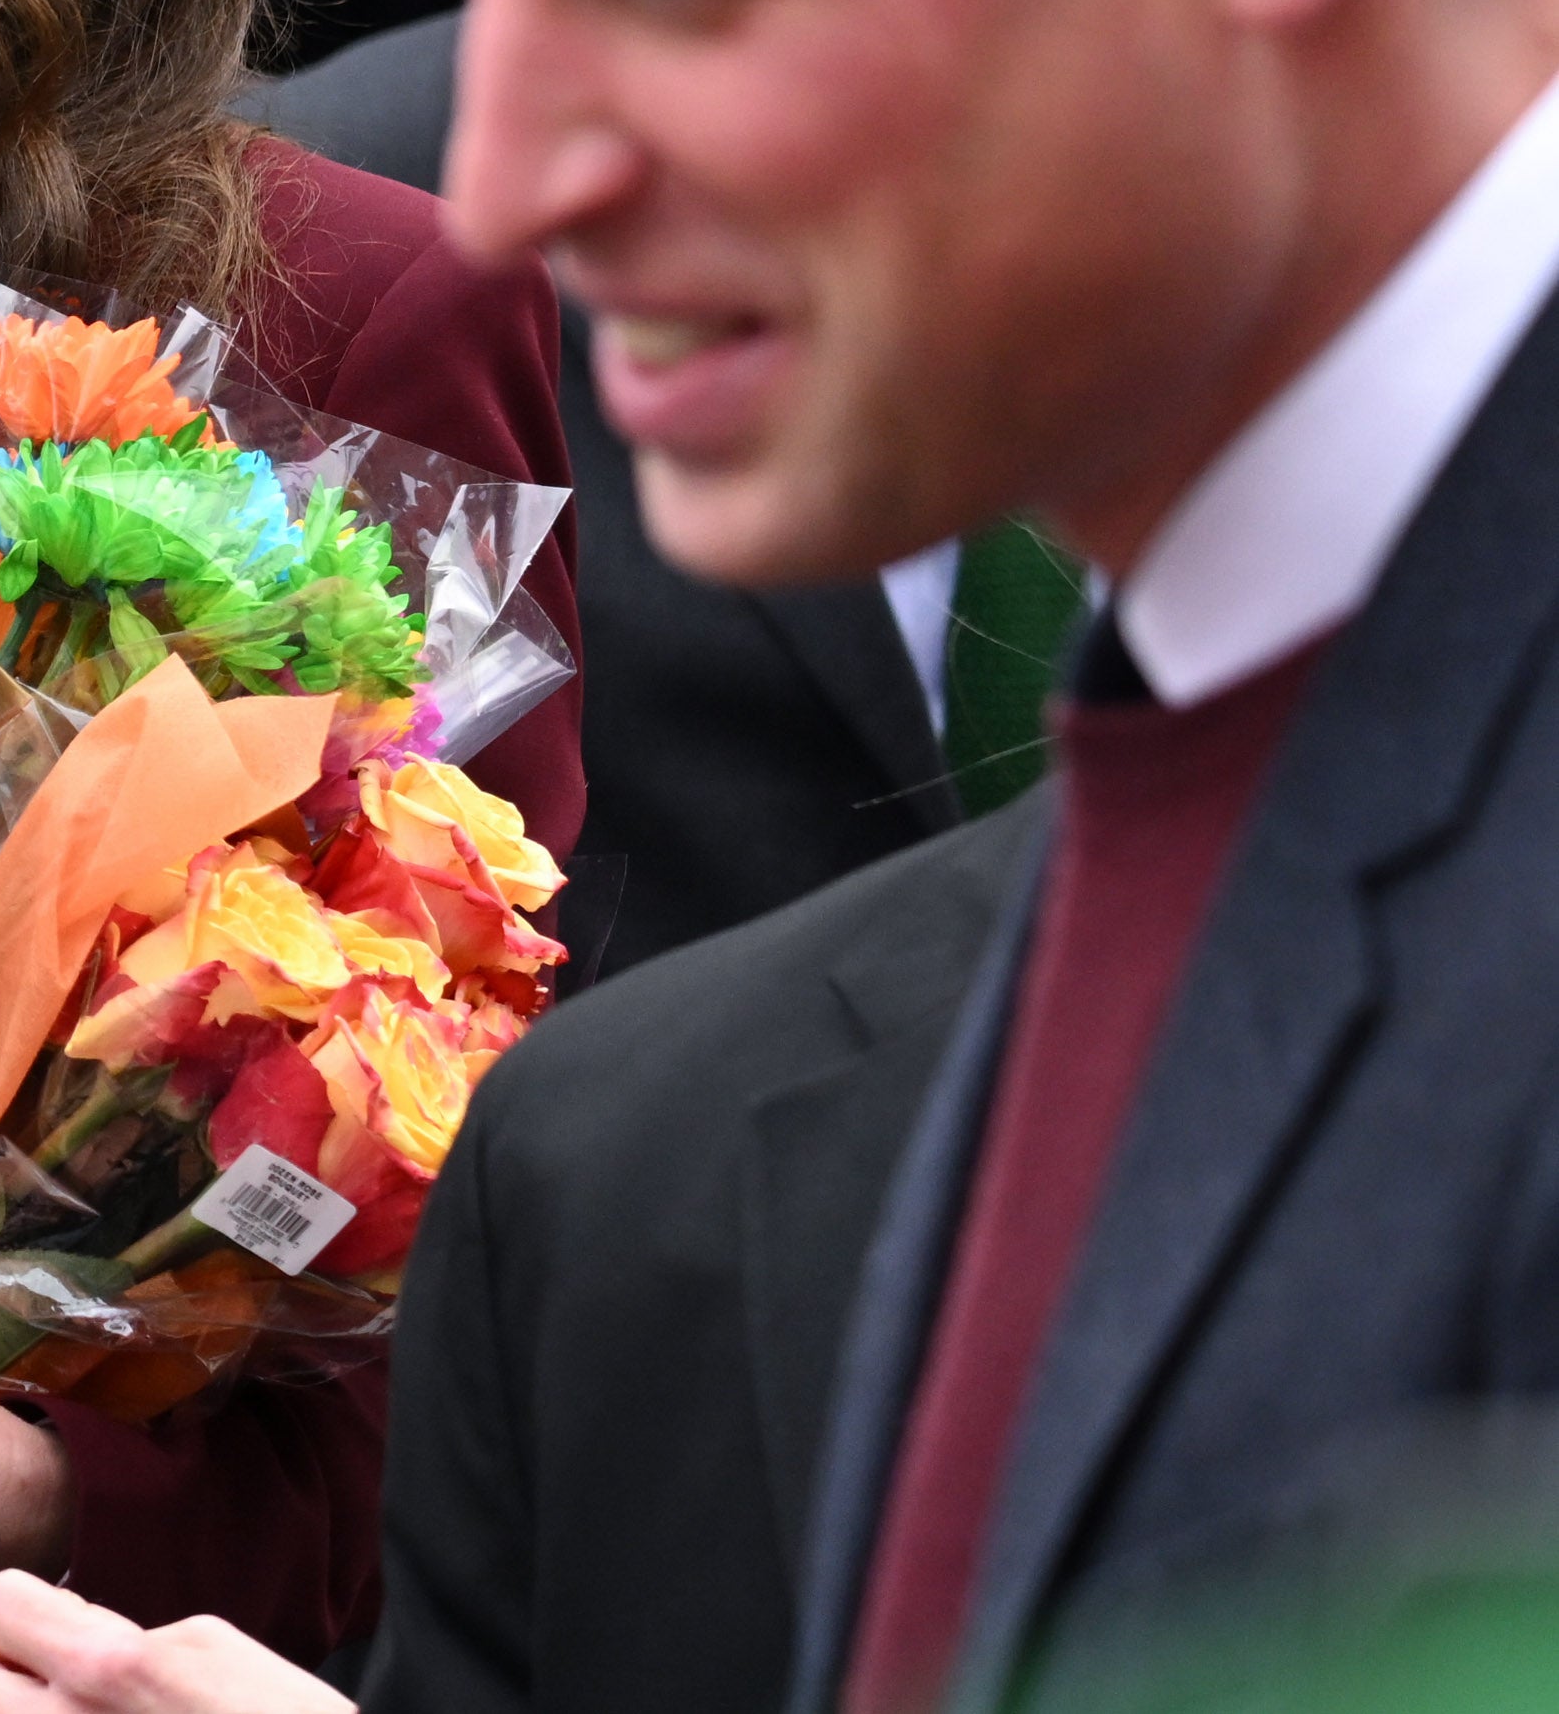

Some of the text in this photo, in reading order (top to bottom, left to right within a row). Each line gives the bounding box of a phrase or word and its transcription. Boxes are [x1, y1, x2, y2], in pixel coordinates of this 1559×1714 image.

[268, 1163, 298, 1183] DOZEN
[298, 1181, 323, 1200] ROSE
[268, 1173, 310, 1202] BOUQUET
